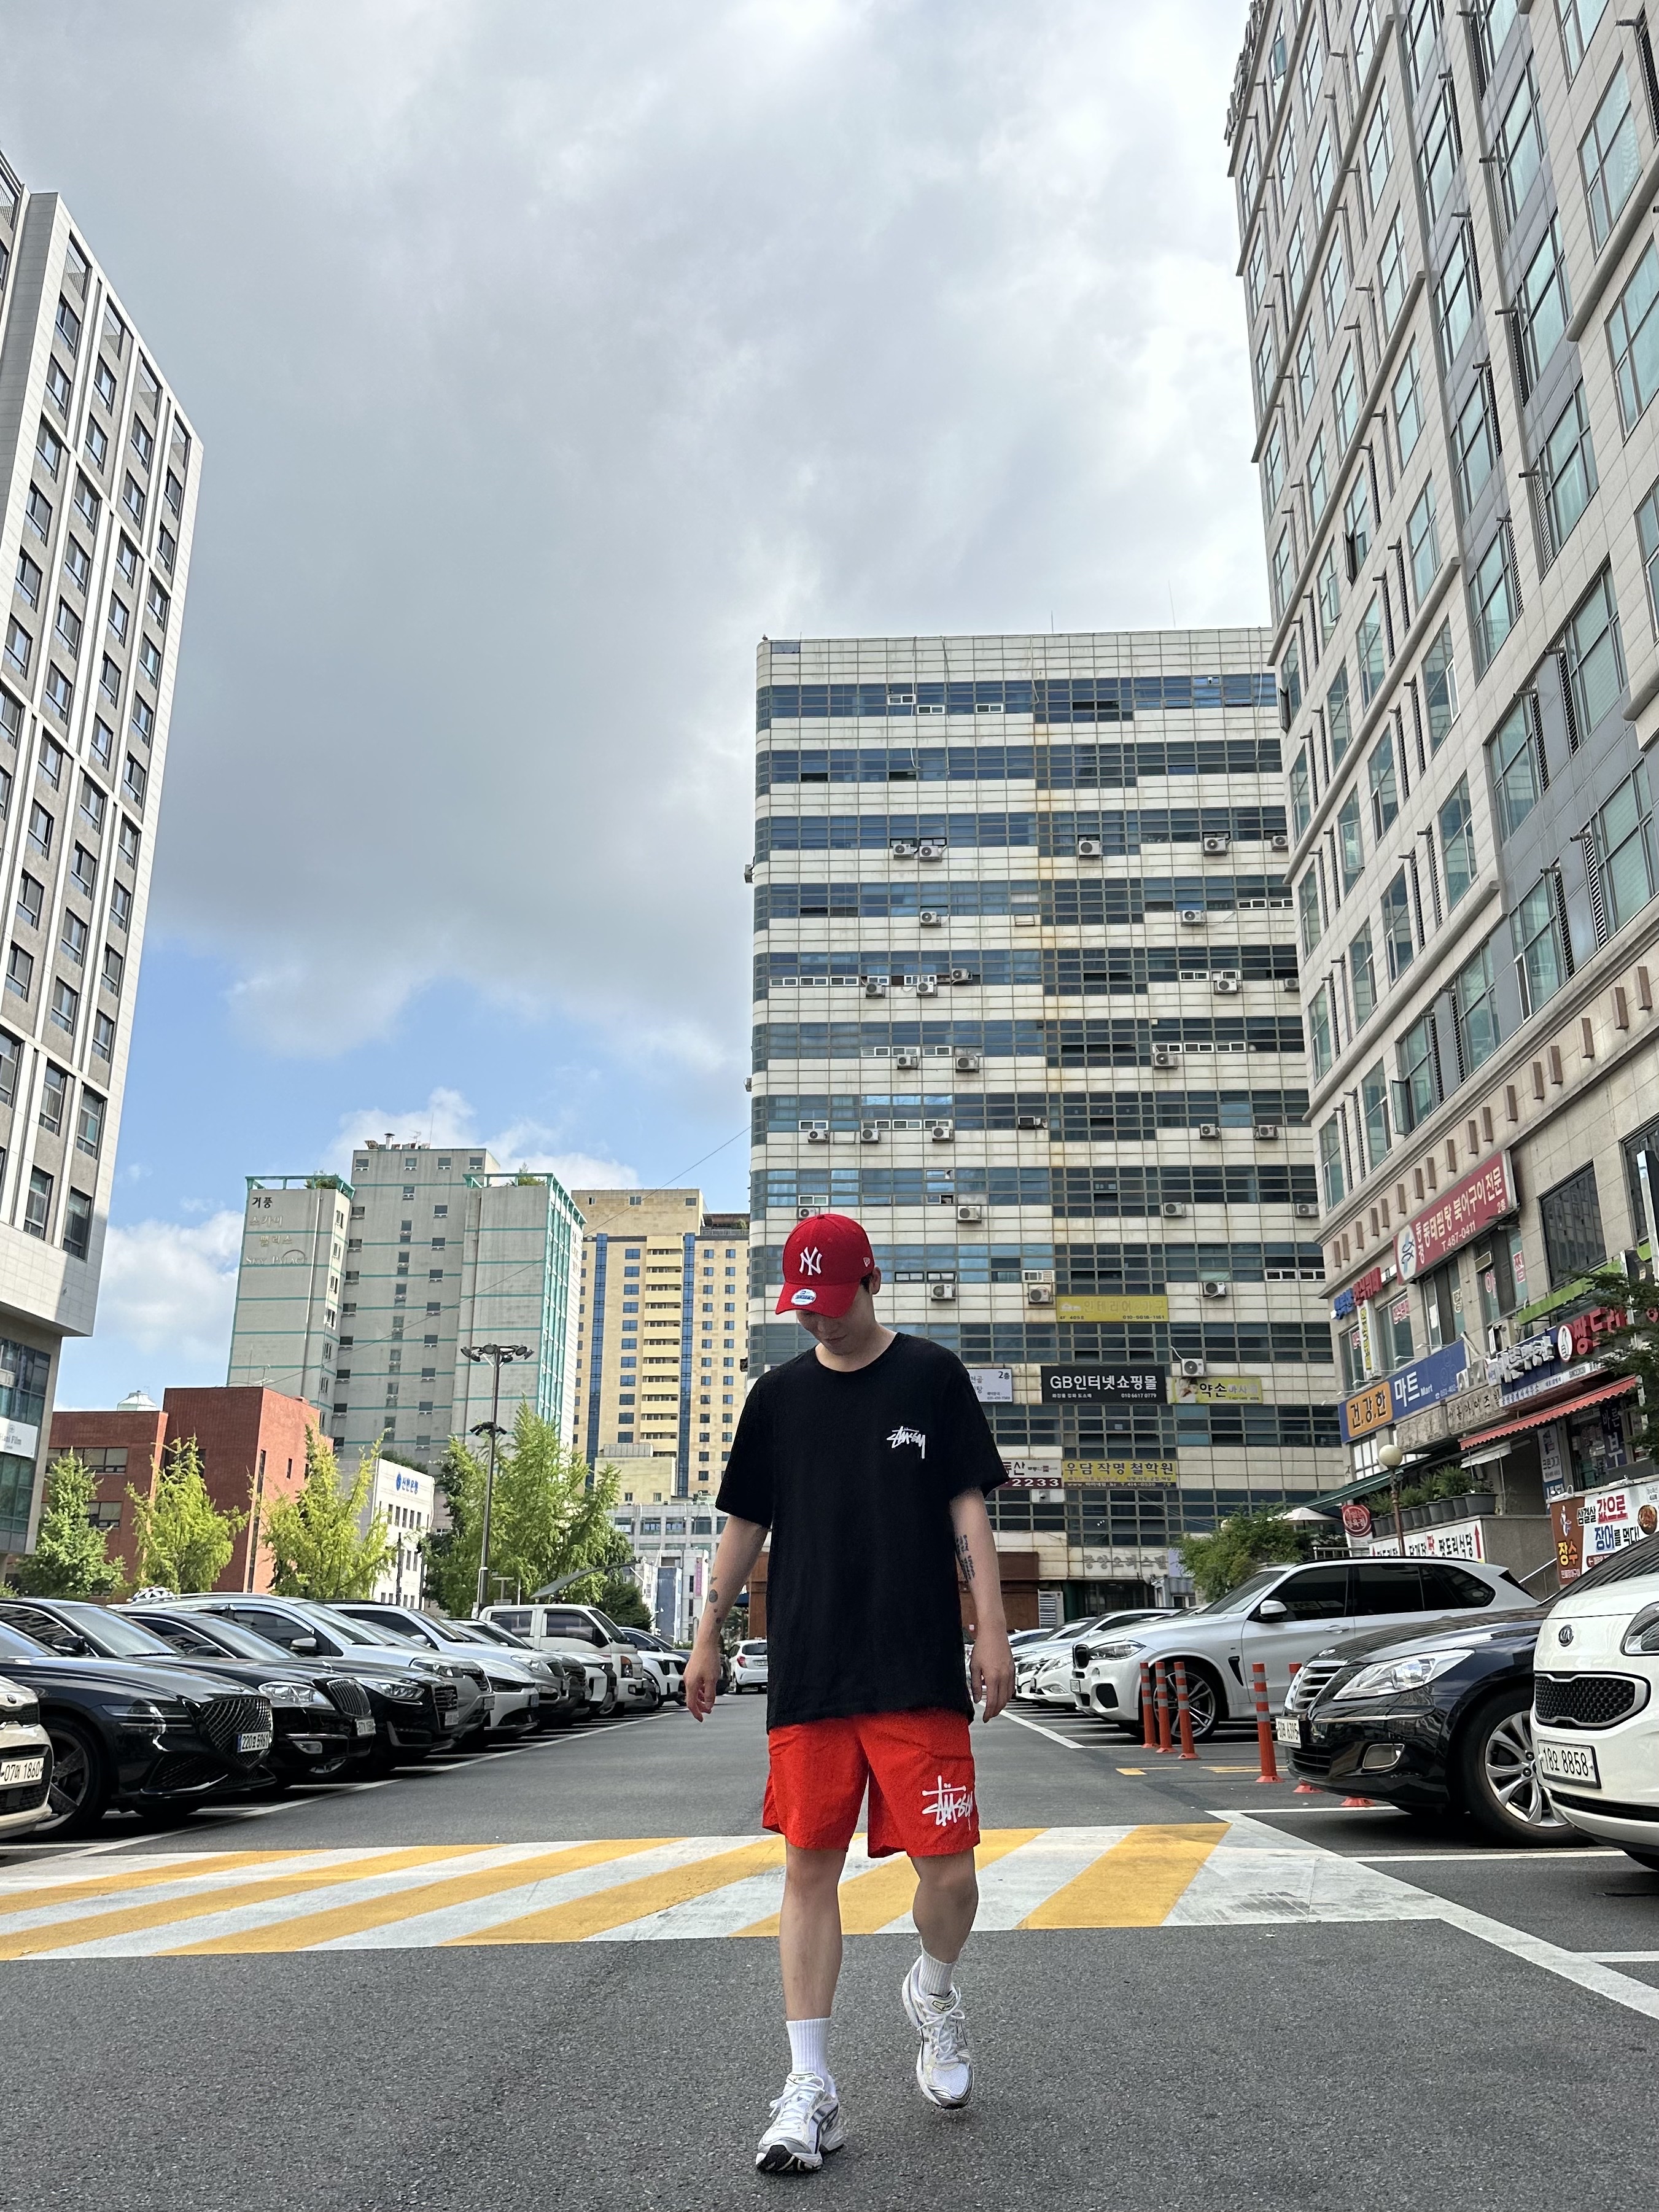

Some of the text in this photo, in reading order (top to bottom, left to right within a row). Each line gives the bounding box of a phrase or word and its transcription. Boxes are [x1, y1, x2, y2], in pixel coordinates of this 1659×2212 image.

[252, 1197, 273, 1209] 거풍
[1423, 1166, 1503, 1248] 동태찜탕 북어구이 전문
[1496, 1198, 1506, 1214] 2층
[249, 1216, 282, 1227] 스카이
[1441, 1220, 1476, 1252] T.487-0411
[246, 1255, 267, 1264] SKY
[799, 1246, 823, 1276] NY
[1084, 1300, 1131, 1313] 인테리어
[998, 1371, 1011, 1380] 2층
[1050, 1375, 1157, 1390] GB인터넷쇼핑몰
[1394, 1371, 1433, 1407] 마트 Mart
[1065, 1462, 1093, 1475] 우담
[1097, 1462, 1125, 1475] 작명
[1130, 1462, 1173, 1475] 철학원
[402, 1477, 418, 1495] 신한은행
[1597, 1494, 1628, 1524] 값으로
[1595, 1525, 1622, 1551] 장어를
[1558, 1540, 1578, 1566] 장수
[24, 1760, 41, 1779] 1860
[1561, 1750, 1589, 1777] 8858
